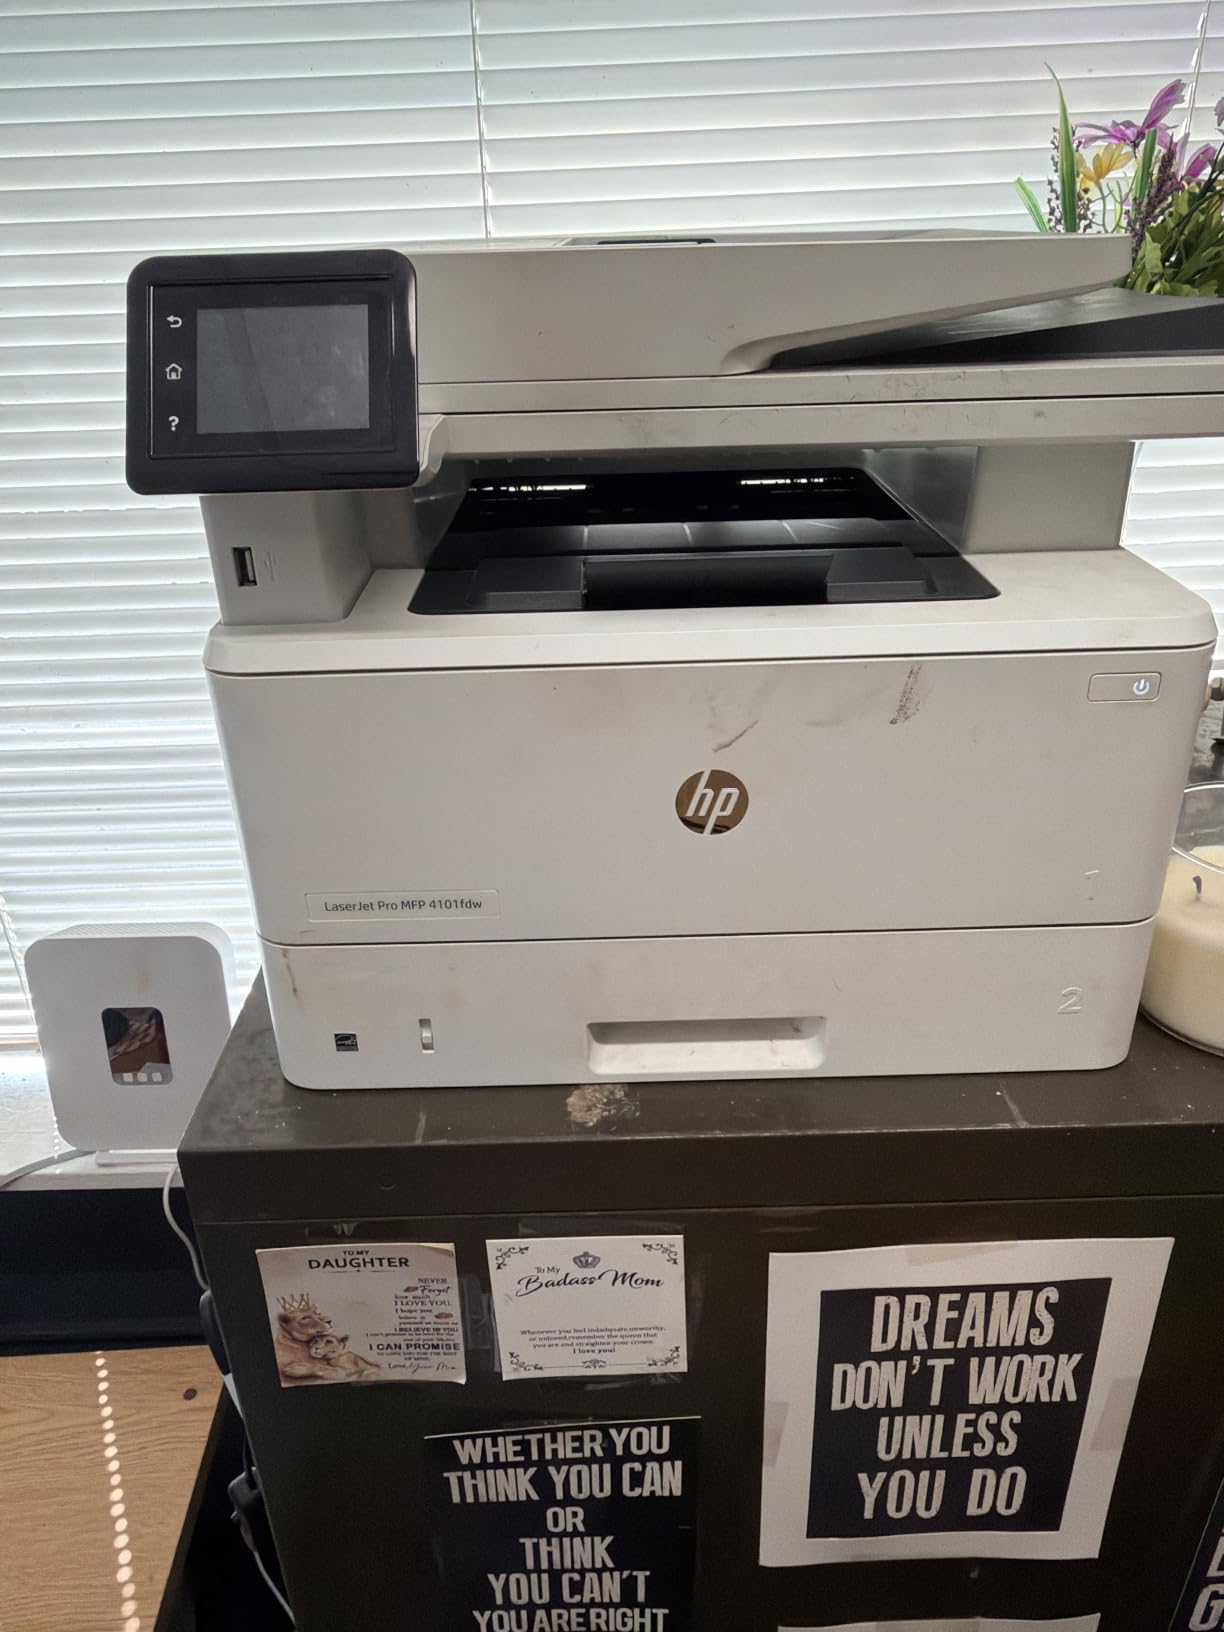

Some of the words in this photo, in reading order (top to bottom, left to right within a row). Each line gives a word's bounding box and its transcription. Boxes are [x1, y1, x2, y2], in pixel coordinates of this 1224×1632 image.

[169, 416, 180, 431] ?
[685, 768, 740, 835] hp
[324, 901, 374, 912] LaserJet
[377, 900, 398, 911] Pro
[400, 899, 426, 910] MFP
[429, 898, 482, 910] 4101fdw
[1057, 987, 1083, 1015] 2
[308, 1257, 410, 1270] DAUGHTER
[534, 1266, 545, 1274] To
[547, 1266, 560, 1275] My
[515, 1272, 596, 1297] Badass
[598, 1269, 665, 1289] Mom
[870, 1286, 1060, 1353] DREAMS
[831, 1355, 955, 1411] DON'T
[968, 1352, 1084, 1406] WORK
[453, 1429, 604, 1465] WHETHER
[609, 1425, 671, 1456] YOU
[876, 1410, 1022, 1461] UNLESS
[443, 1466, 540, 1504] THINK
[548, 1463, 612, 1500] YOU
[621, 1460, 683, 1498] CAN
[857, 1469, 946, 1519] YOU
[966, 1465, 1028, 1517] DO
[546, 1506, 585, 1533] OR
[519, 1535, 615, 1570] THINK
[487, 1573, 550, 1605] YOU
[561, 1570, 650, 1604] CAN'T
[472, 1609, 528, 1632] YOU
[532, 1608, 586, 1632] ARE
[589, 1607, 669, 1632] RIGHT
